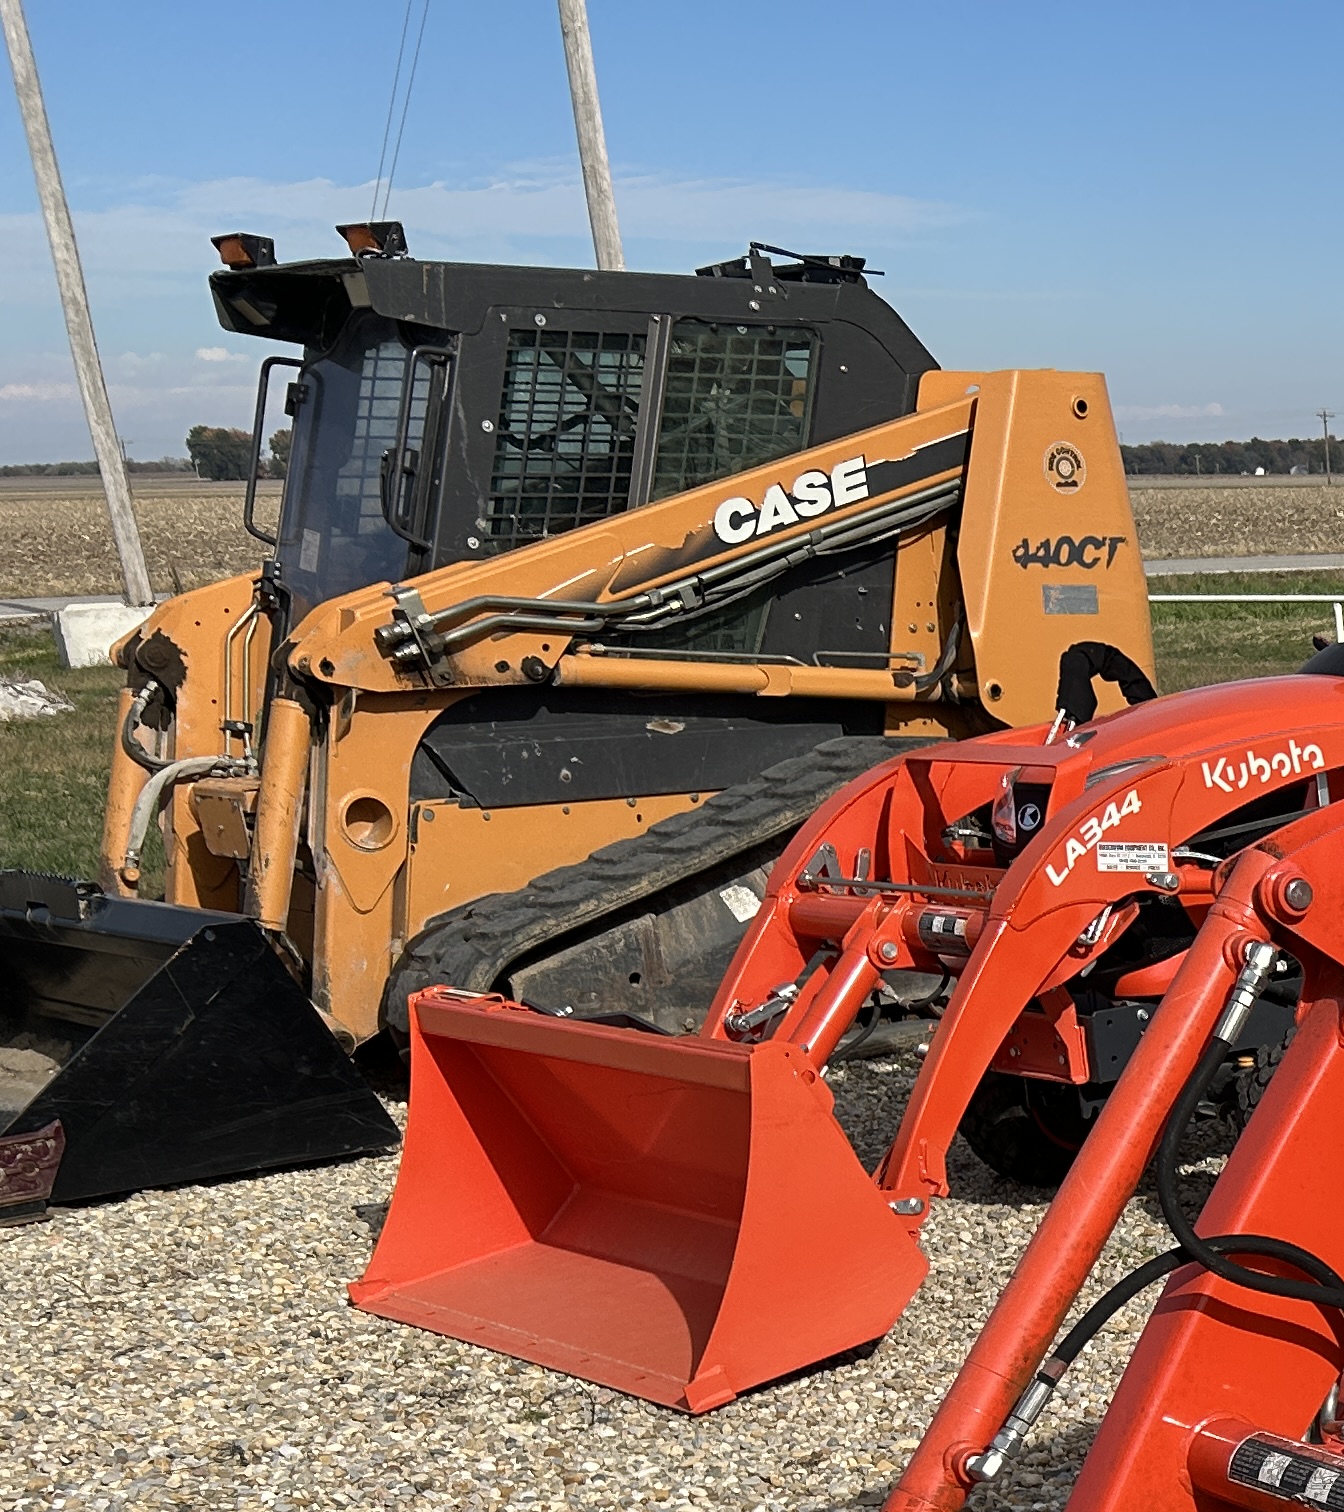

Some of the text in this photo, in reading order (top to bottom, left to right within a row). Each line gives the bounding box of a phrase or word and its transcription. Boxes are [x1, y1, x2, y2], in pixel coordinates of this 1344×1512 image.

[713, 454, 870, 545] CASE
[1011, 535, 1127, 570] 440CT
[1200, 738, 1326, 793] Kubota
[1045, 789, 1143, 888] LA344
